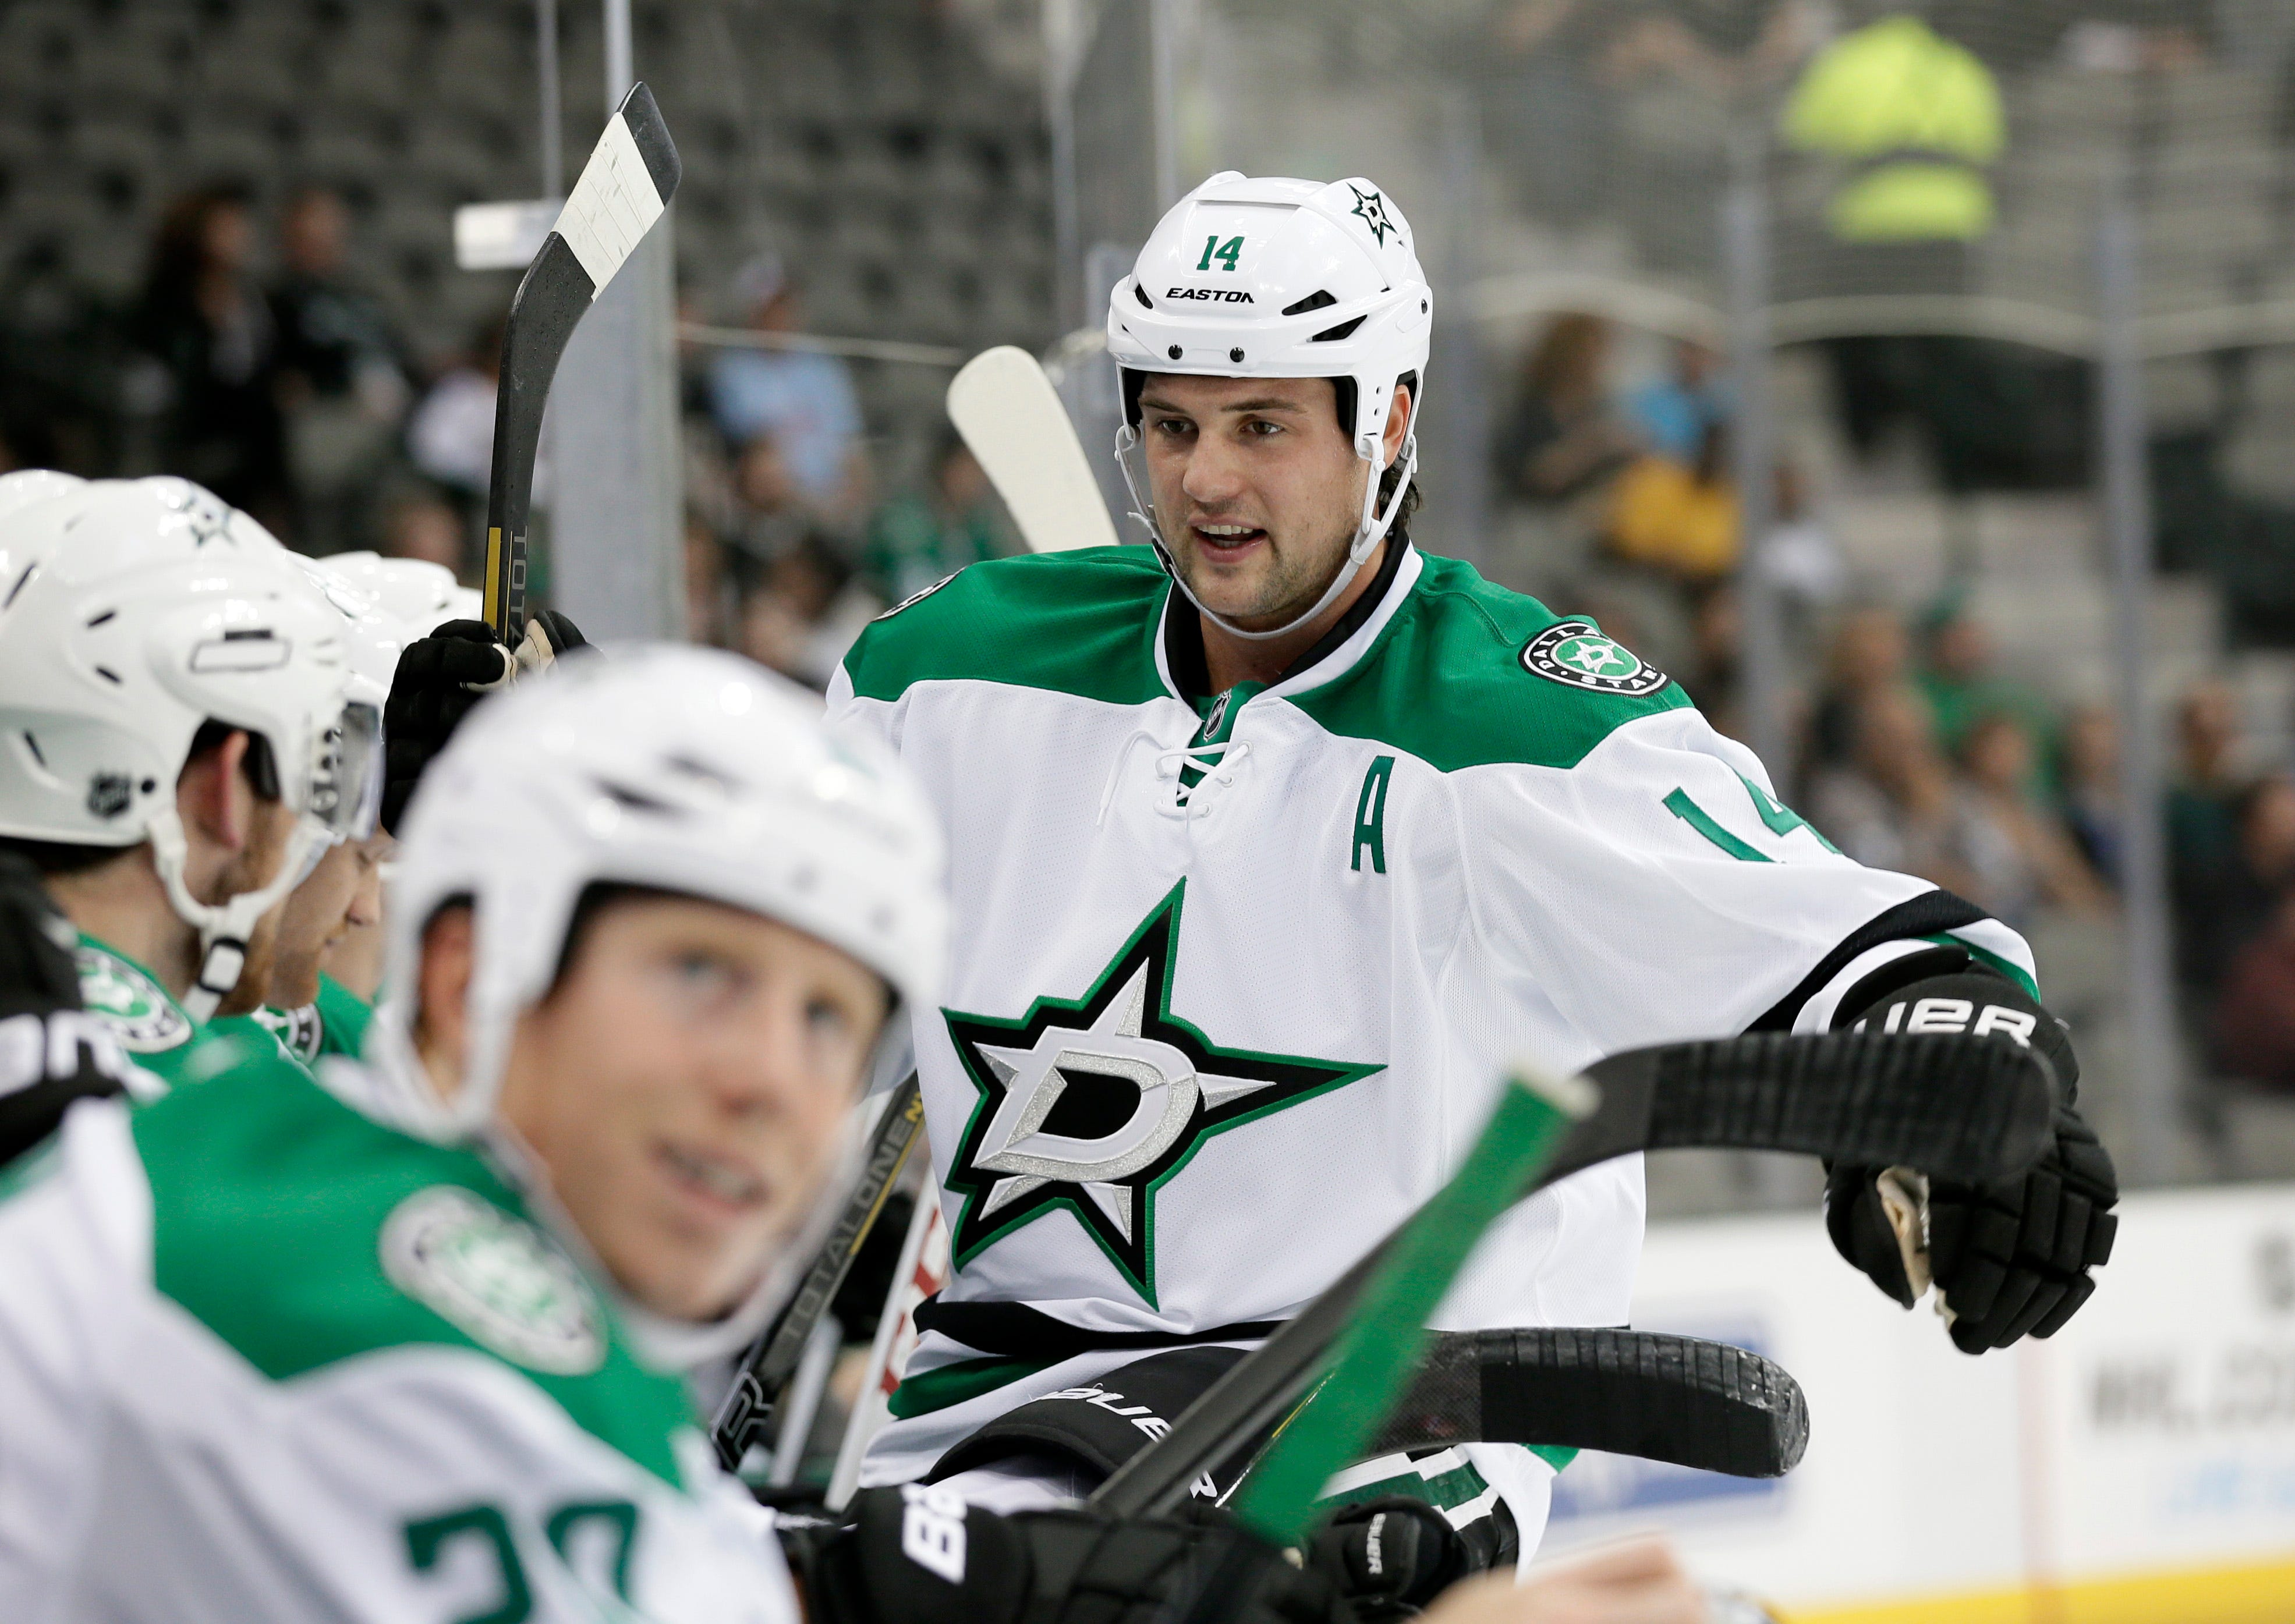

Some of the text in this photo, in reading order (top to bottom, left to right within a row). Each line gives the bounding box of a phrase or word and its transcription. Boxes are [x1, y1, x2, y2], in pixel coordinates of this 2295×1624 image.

[1196, 235, 1245, 271] 14
[1166, 288, 1255, 304] EASTON
[1351, 756, 1395, 874] A
